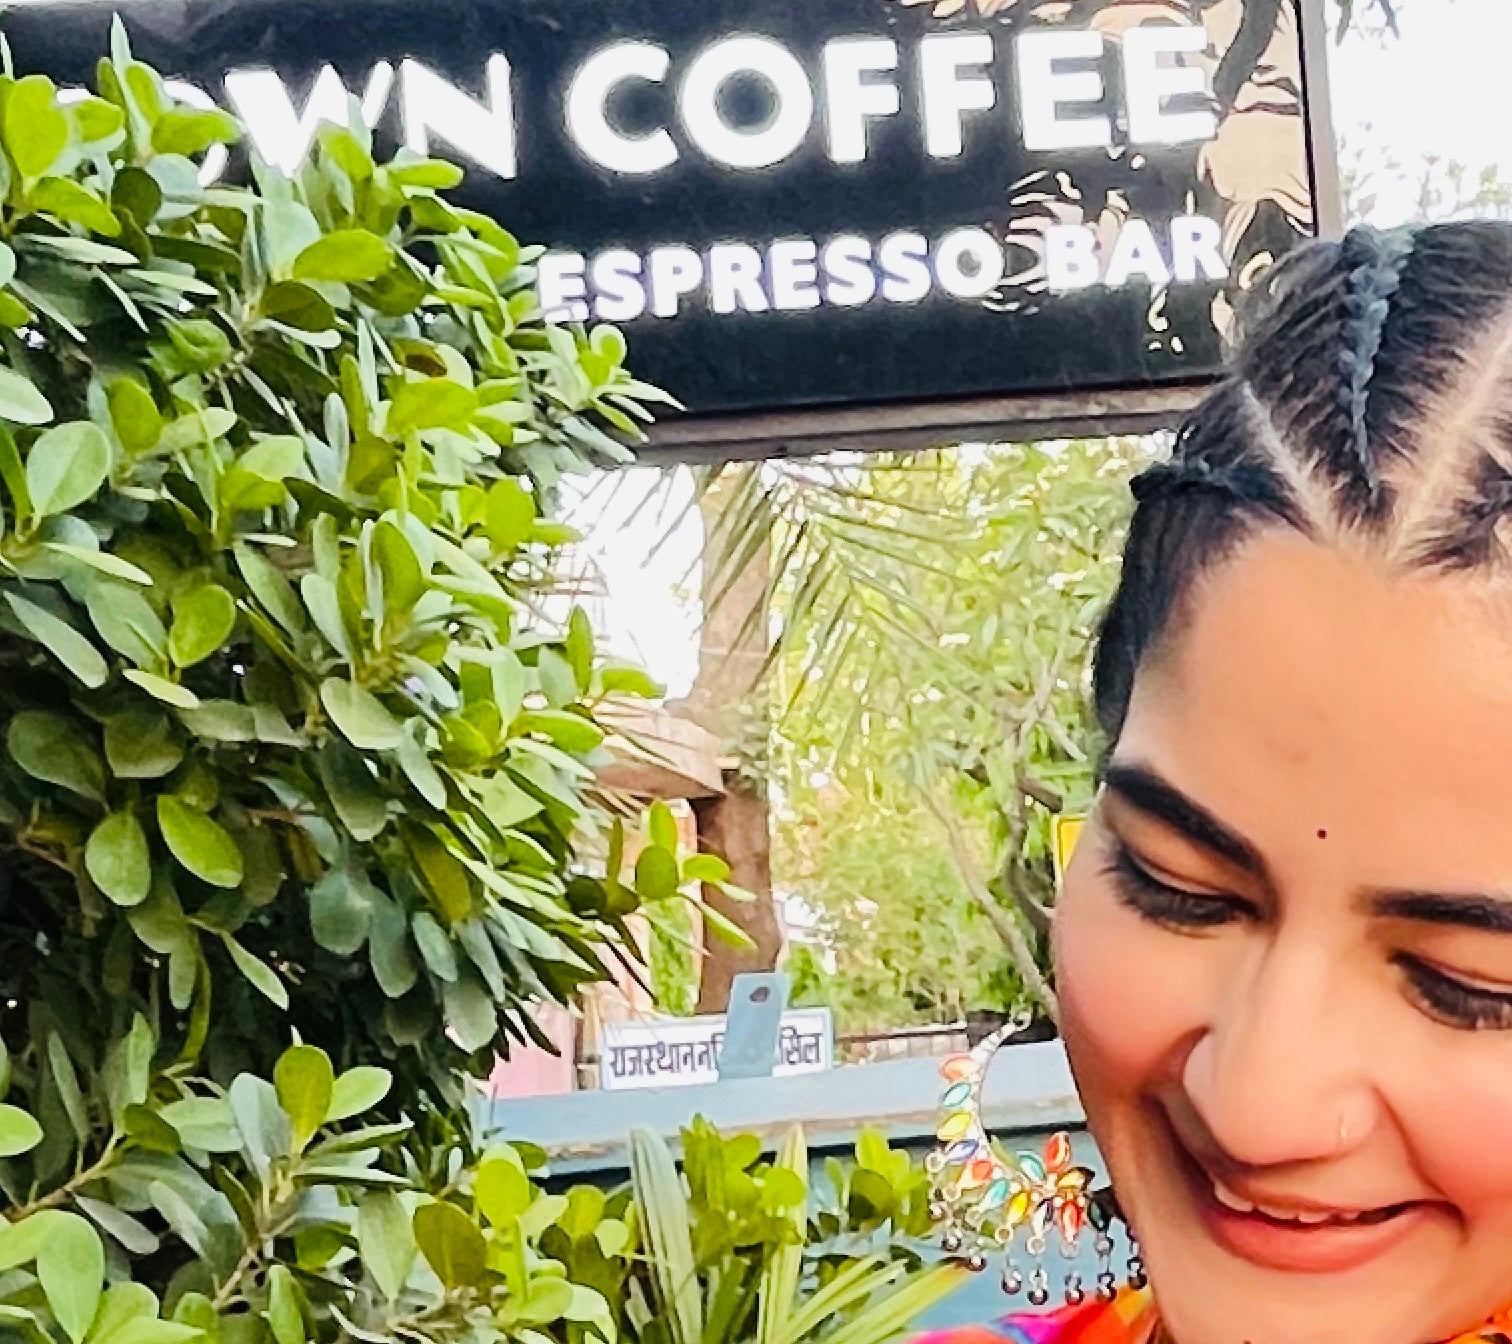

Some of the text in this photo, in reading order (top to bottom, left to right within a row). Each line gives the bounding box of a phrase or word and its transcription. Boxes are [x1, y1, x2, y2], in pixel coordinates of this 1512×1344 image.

[56, 26, 1217, 188] WN COFFEE
[535, 214, 1227, 325] ESPRESSO BAR
